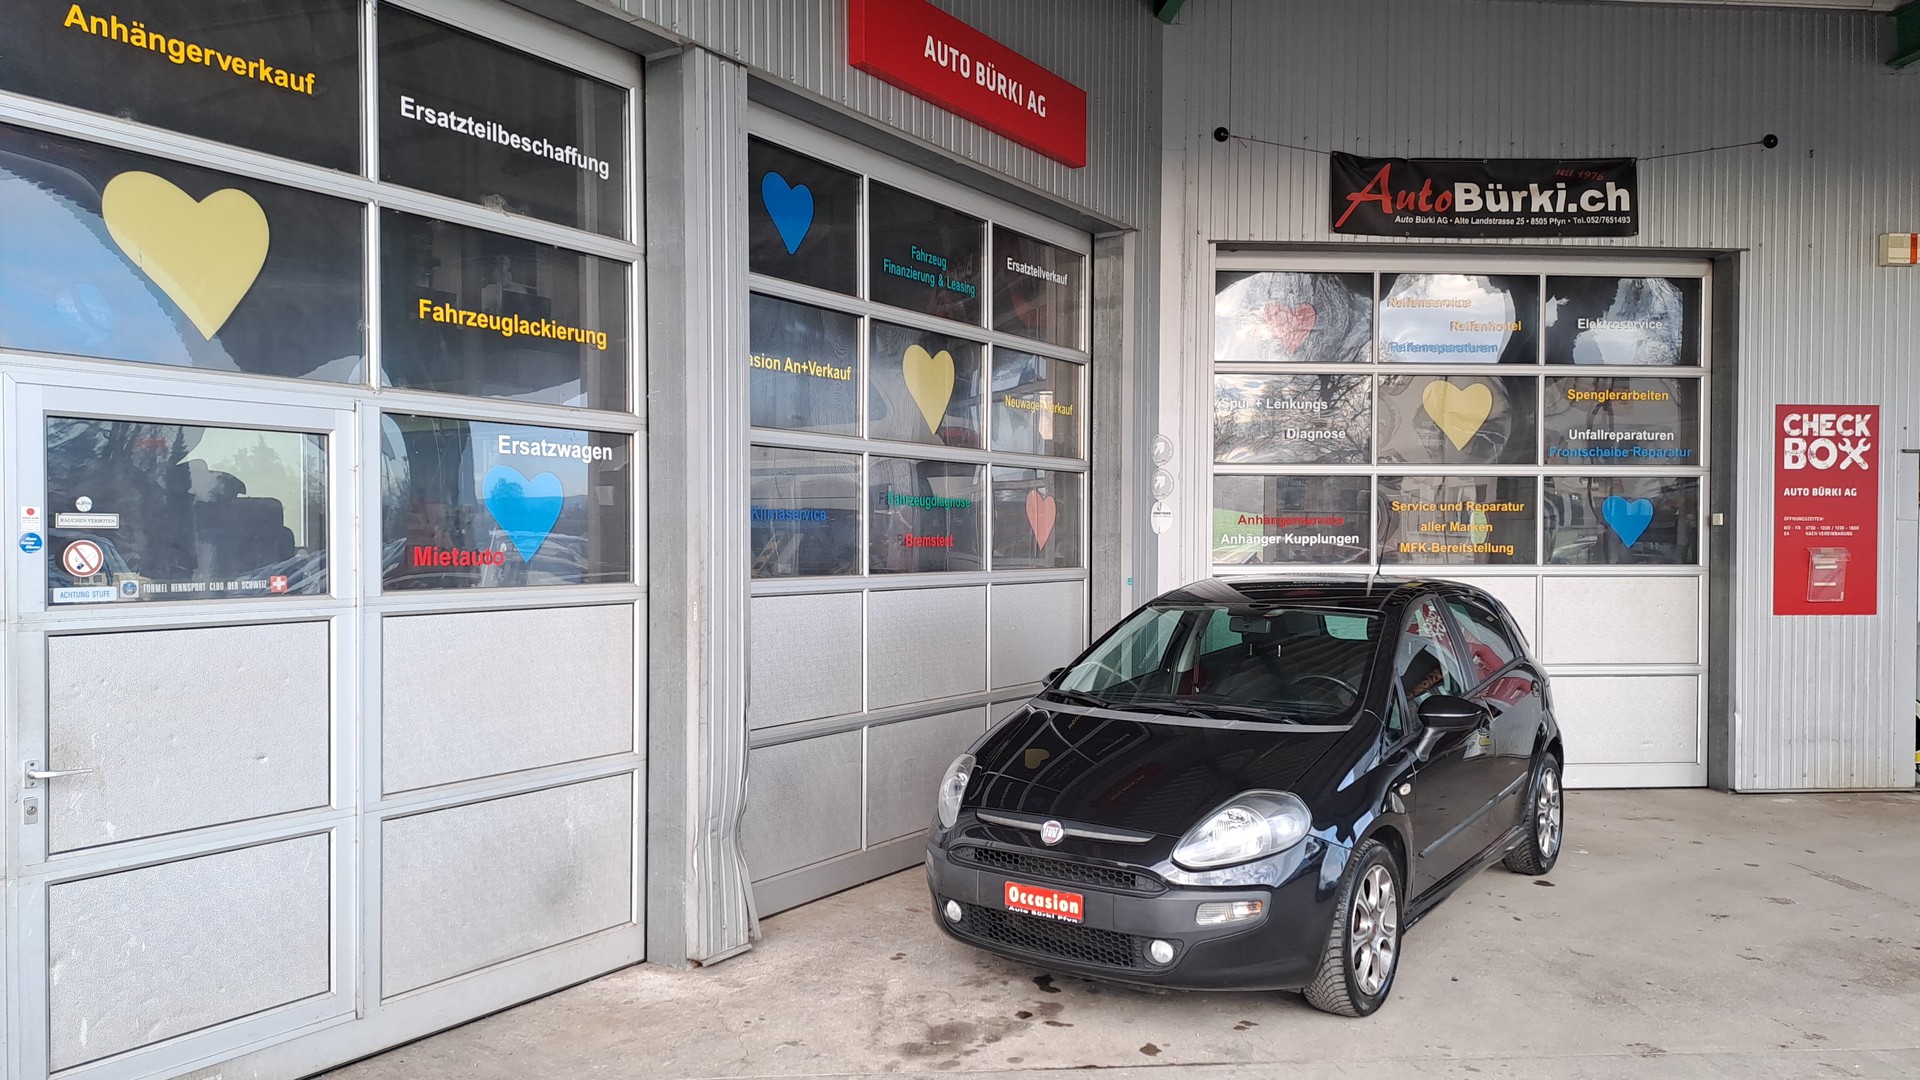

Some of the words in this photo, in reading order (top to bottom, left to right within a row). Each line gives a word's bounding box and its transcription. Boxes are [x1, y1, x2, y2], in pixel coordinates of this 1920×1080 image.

[64, 5, 315, 95] Anhängerverkauf
[924, 35, 970, 79] AUTO
[975, 61, 1023, 106] BÜRKI
[1027, 90, 1046, 118] AG
[401, 96, 609, 180] Ersatzteilbeschaffung
[1555, 168, 1574, 178] seit
[1578, 169, 1604, 181] 1976
[1395, 215, 1413, 224] Auto
[1415, 215, 1435, 224] Bürki
[1437, 216, 1448, 224] AG
[1454, 217, 1469, 225] Alte
[1470, 217, 1514, 226] Landstrasse
[1516, 218, 1525, 226] 25
[1531, 218, 1547, 226] 8505
[1549, 217, 1566, 227] Pfyn
[911, 245, 947, 270] Fahrzeug
[883, 257, 935, 287] Finanzierung
[938, 275, 944, 286] &
[947, 276, 976, 299] Leasing
[1007, 257, 1068, 286] Ersatzteilverkauf
[1388, 297, 1472, 308] Reifenservice
[418, 299, 607, 350] Fahrzeuglackierung
[1452, 320, 1522, 332] Reifenhotel
[1577, 318, 1663, 330] Elektroservice
[784, 357, 851, 381] An+Verkauf
[1567, 388, 1669, 403] Spenglerarbeiten
[1221, 397, 1249, 410] Spur
[1266, 398, 1328, 412] Lenkungs
[1783, 413, 1872, 436] CHECK
[1286, 428, 1346, 442] Diagnose
[1569, 429, 1675, 442] Unfallreparaturen
[498, 435, 613, 464] Ersatzwagen
[1550, 446, 1628, 458] Frontscheibe
[1633, 446, 1691, 459] Reparatur
[1784, 437, 1871, 470] BOX
[1783, 487, 1809, 497] AUTO
[1812, 486, 1841, 497] BÜRKI
[1844, 487, 1857, 497] AG
[887, 491, 971, 510] Fahrzeugdiagnose
[1391, 501, 1439, 512] Service
[1440, 501, 1463, 512] und
[1466, 501, 1525, 513] Reparatur
[752, 507, 827, 521] Klimaservice
[1238, 514, 1345, 528] Anhängerservice
[1420, 521, 1446, 532] aller
[1450, 521, 1493, 532] Marken
[904, 532, 954, 548] Bremstest
[1221, 533, 1281, 546] Anhänger
[1285, 533, 1359, 546] Kupplungen
[1399, 542, 1514, 555] MFK-Bereitstellung
[413, 545, 505, 567] Mietauto
[242, 580, 267, 590] SCHWEIZ
[60, 591, 90, 599] ACHTUNG
[92, 590, 111, 598] STUFE
[1009, 886, 1079, 915] Occasion
